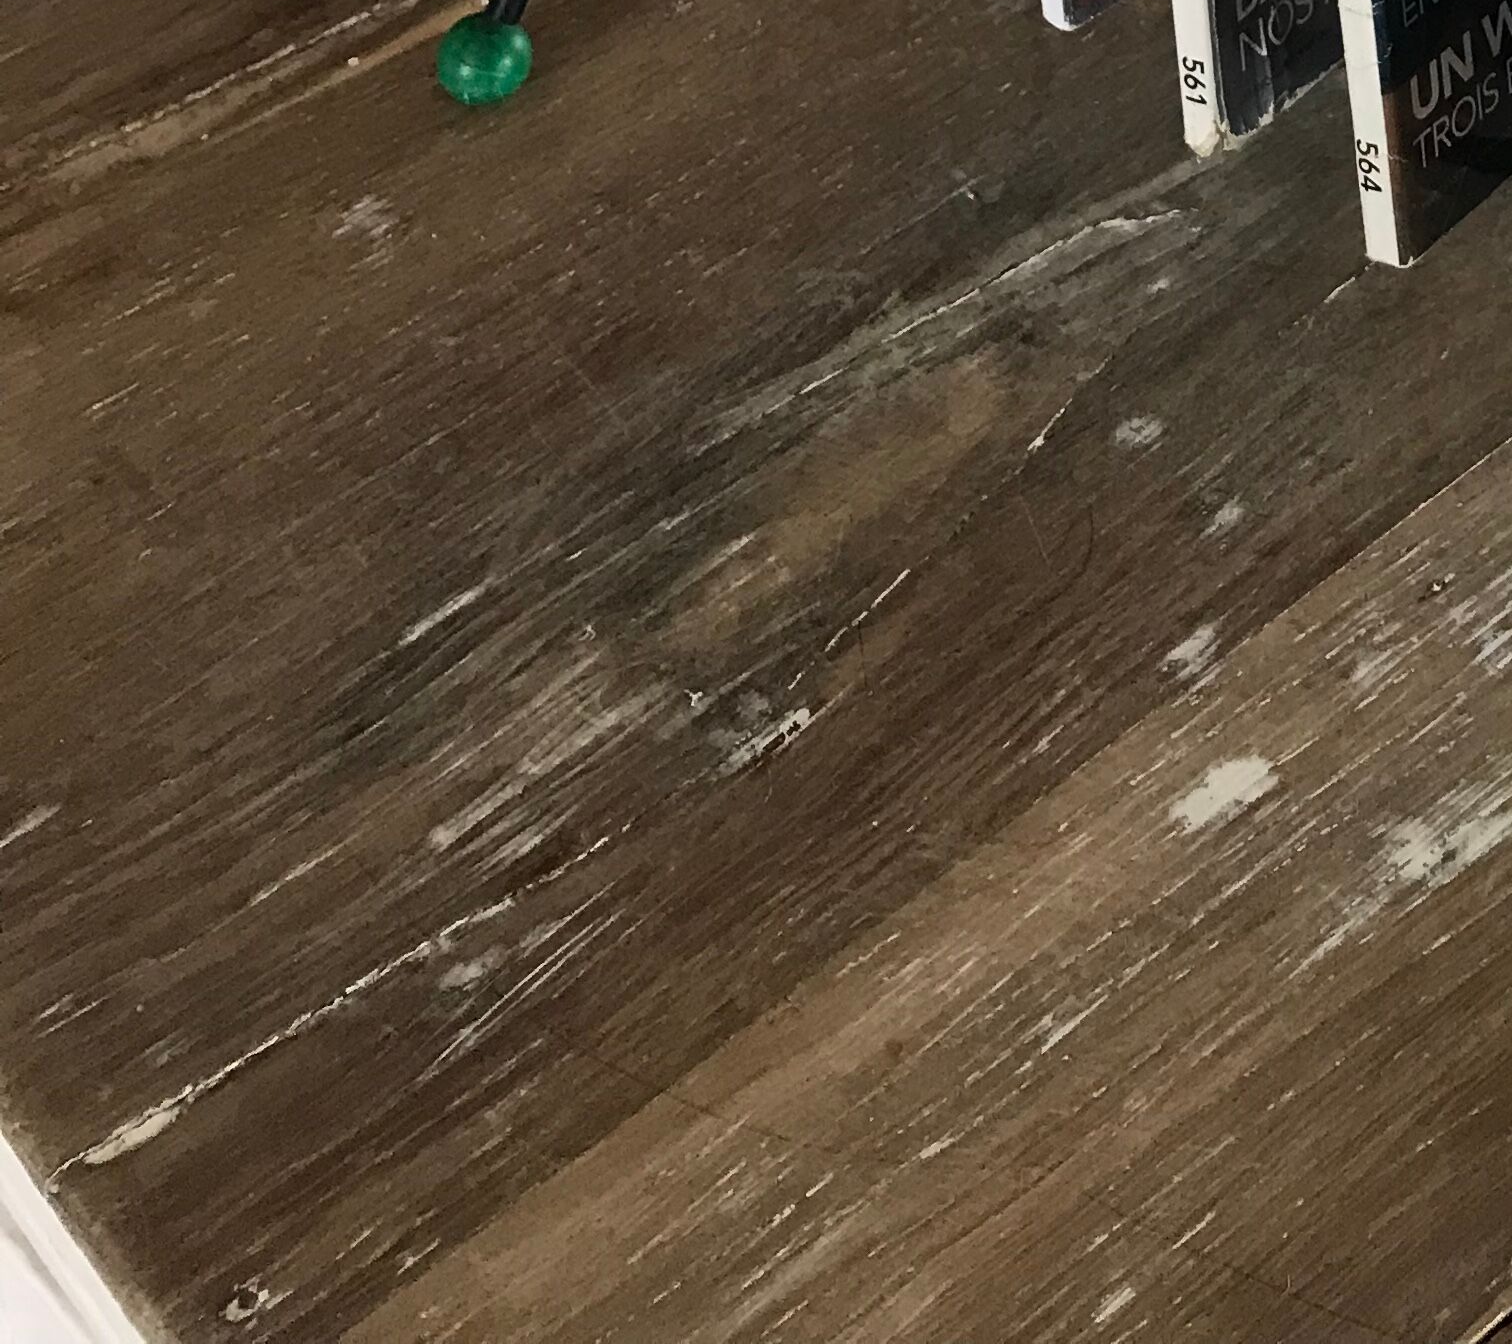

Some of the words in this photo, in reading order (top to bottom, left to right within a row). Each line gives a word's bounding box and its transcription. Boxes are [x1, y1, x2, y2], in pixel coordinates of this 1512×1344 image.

[1181, 54, 1208, 106] 561
[1410, 30, 1475, 120] UN
[1413, 72, 1500, 169] TROIS
[1354, 137, 1384, 194] 564
